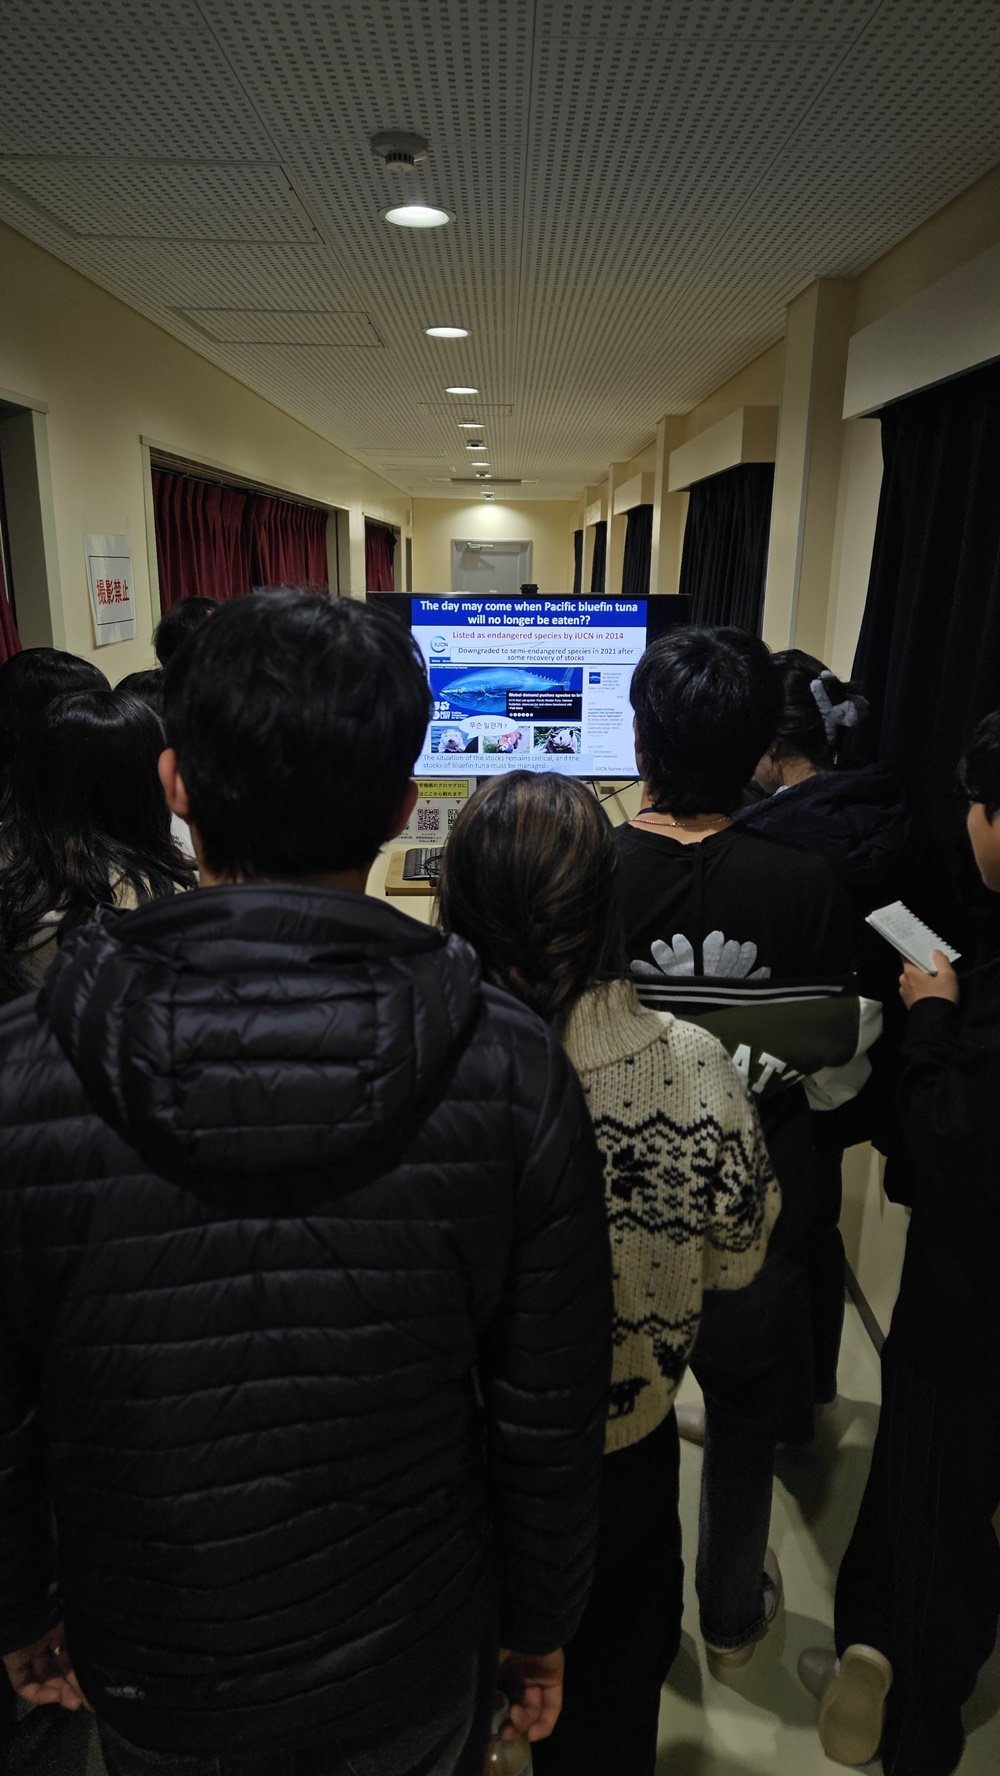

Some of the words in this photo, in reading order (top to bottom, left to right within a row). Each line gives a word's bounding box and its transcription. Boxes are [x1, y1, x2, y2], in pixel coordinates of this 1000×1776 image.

[96, 579, 130, 605] 撮影禁止
[420, 601, 439, 611] The
[441, 601, 460, 613] day
[461, 603, 483, 613] may
[485, 603, 512, 611] come
[514, 601, 542, 611] when
[544, 601, 576, 612] Pacific
[578, 602, 613, 612] bluefin
[615, 603, 638, 612] tuna
[467, 614, 486, 625] will
[488, 616, 501, 625] no
[503, 614, 535, 627] longer
[537, 615, 550, 625] be
[551, 615, 591, 625] eaten??
[452, 631, 475, 639] Listed
[487, 631, 532, 640] endangered
[534, 632, 562, 640] species
[563, 632, 572, 640] by
[458, 647, 500, 656] Downgraded
[509, 647, 566, 655] semi-endangered
[567, 647, 591, 655] species
